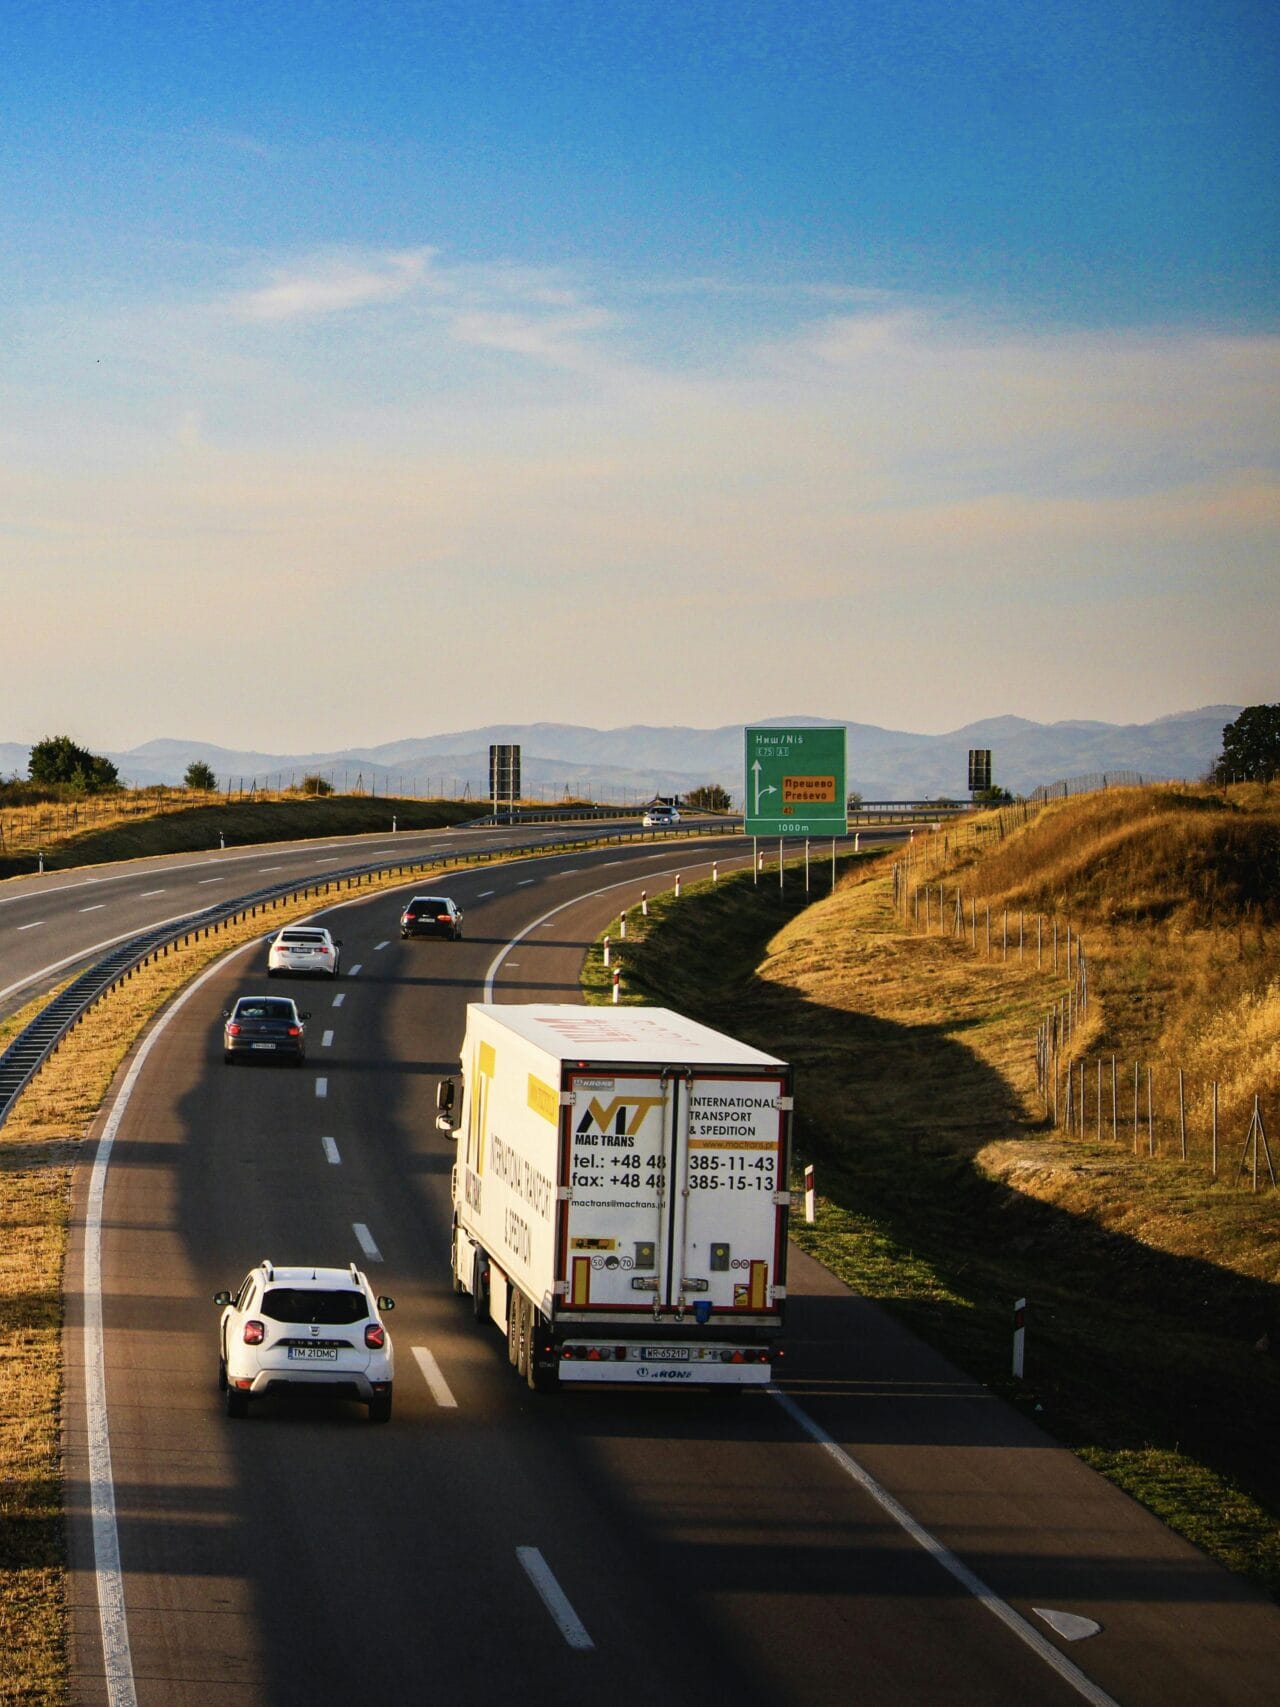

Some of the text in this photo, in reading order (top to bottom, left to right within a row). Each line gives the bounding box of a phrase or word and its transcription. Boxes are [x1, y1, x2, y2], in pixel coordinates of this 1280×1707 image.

[785, 779, 833, 790] Прешево
[690, 1097, 777, 1109] INTERNATIONAL
[689, 1111, 752, 1121] TRANSPORT
[689, 1126, 756, 1136] & SPEDITION
[575, 1135, 635, 1147] MAC TRANS
[574, 1154, 774, 1171] tel.: +48 48 385-11-43
[572, 1172, 774, 1190] fax: +48 48 385-15-13
[593, 1259, 603, 1267] 50
[622, 1259, 632, 1267] 70
